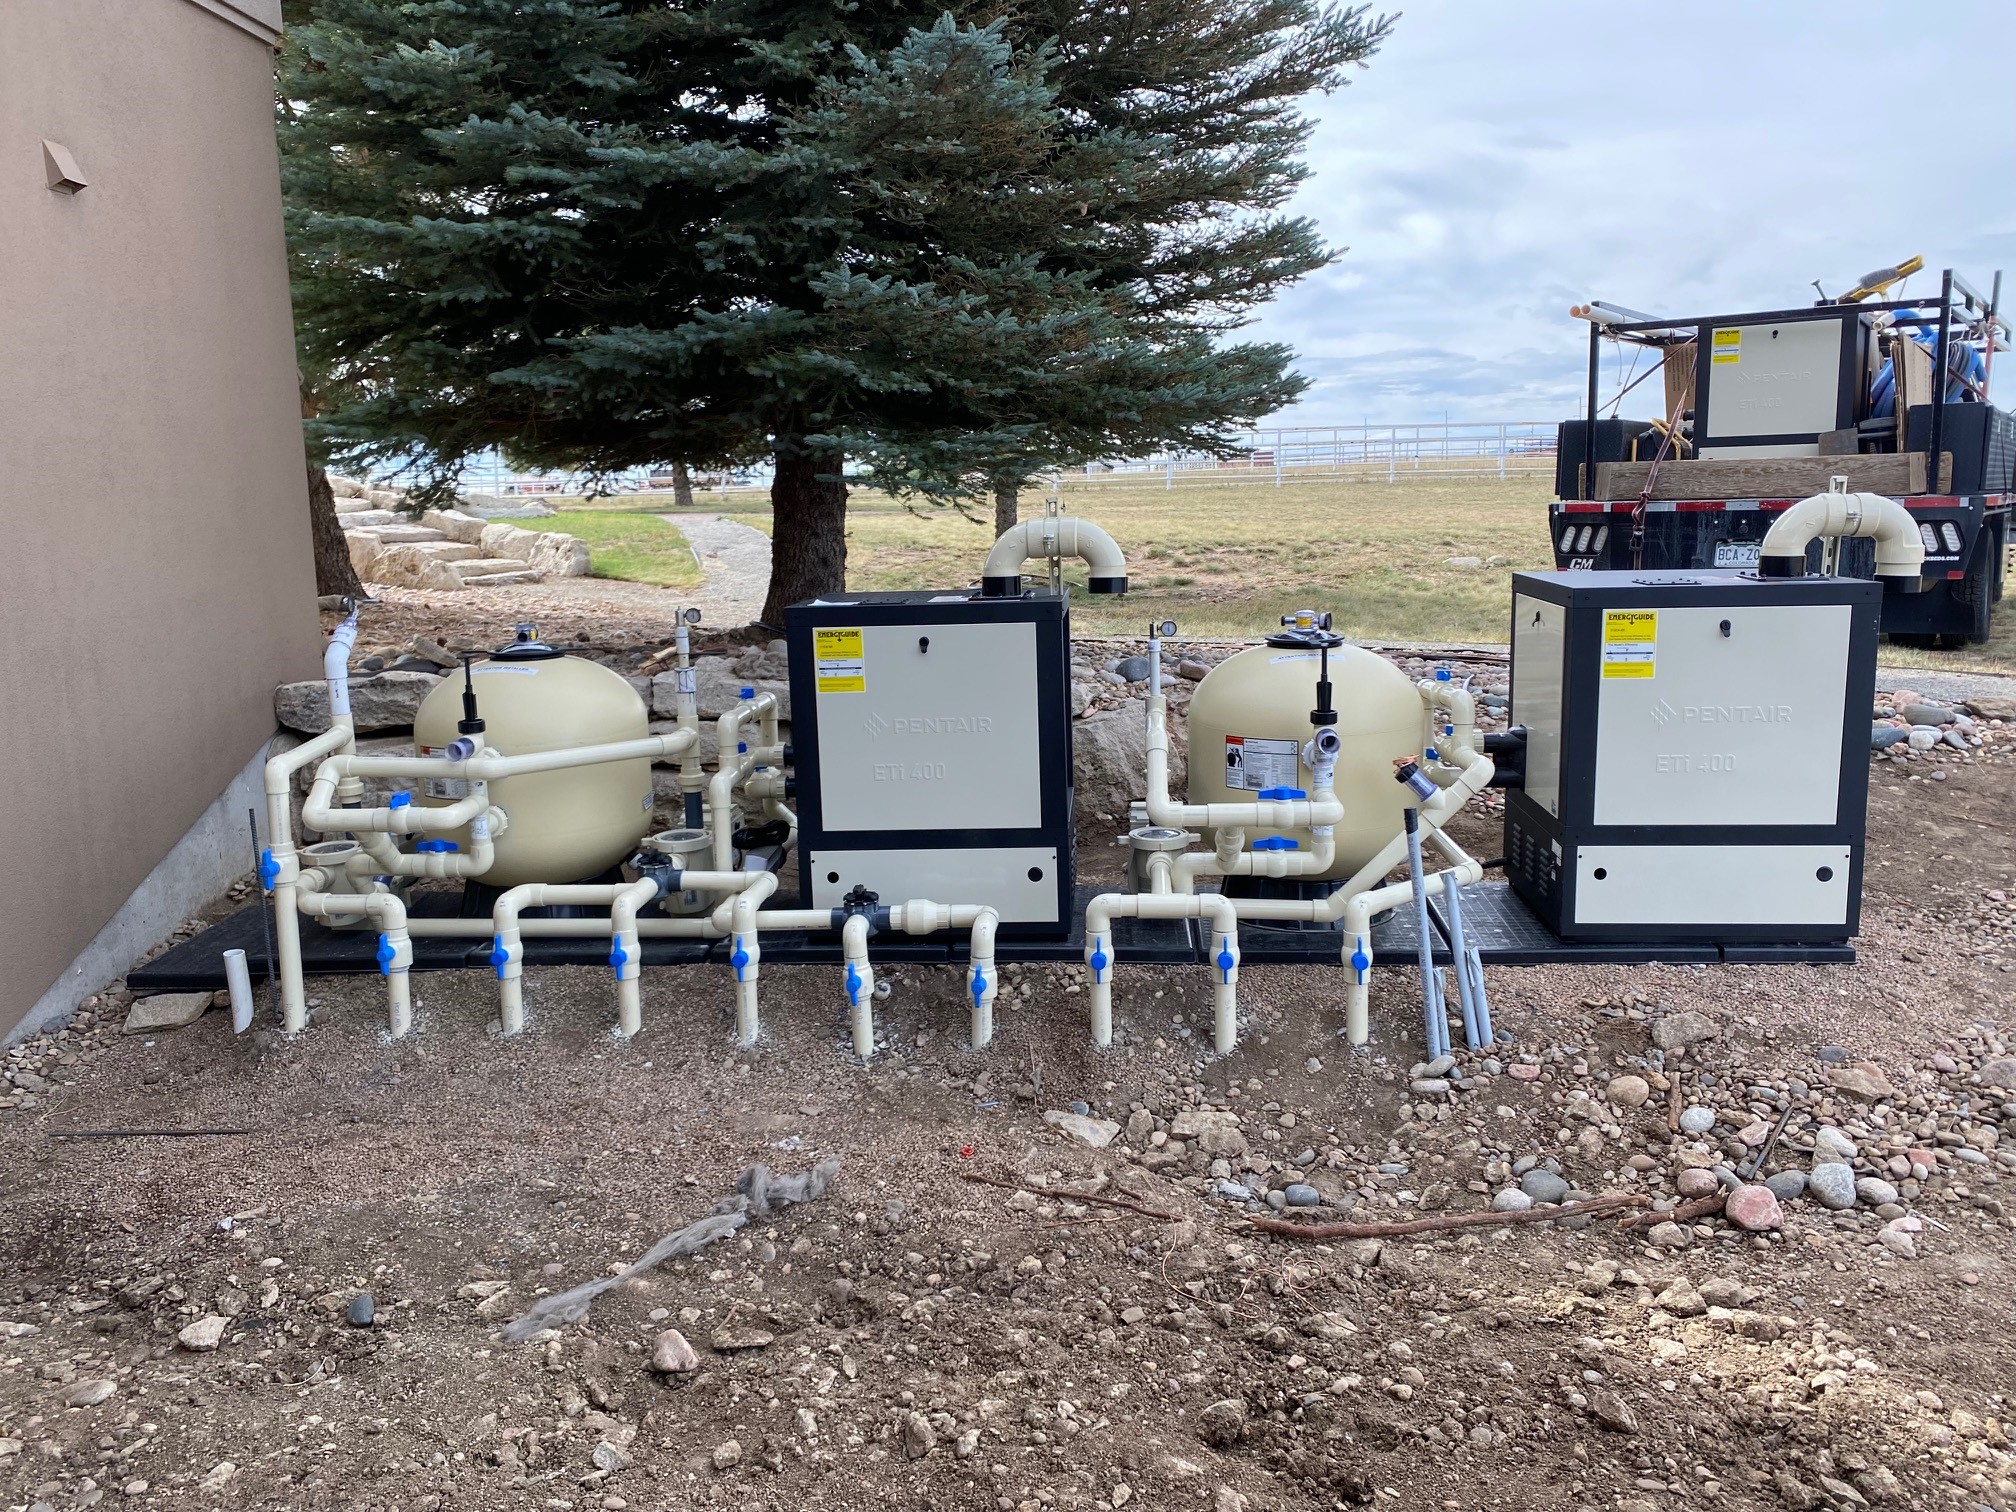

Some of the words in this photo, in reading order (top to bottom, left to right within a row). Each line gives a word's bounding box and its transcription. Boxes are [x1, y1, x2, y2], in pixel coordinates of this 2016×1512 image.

[1569, 557, 1594, 569] CM
[1682, 705, 1793, 724] PENTAIR
[892, 716, 992, 735] PENTAIR
[909, 762, 946, 781] 400
[1696, 753, 1737, 773] 400
